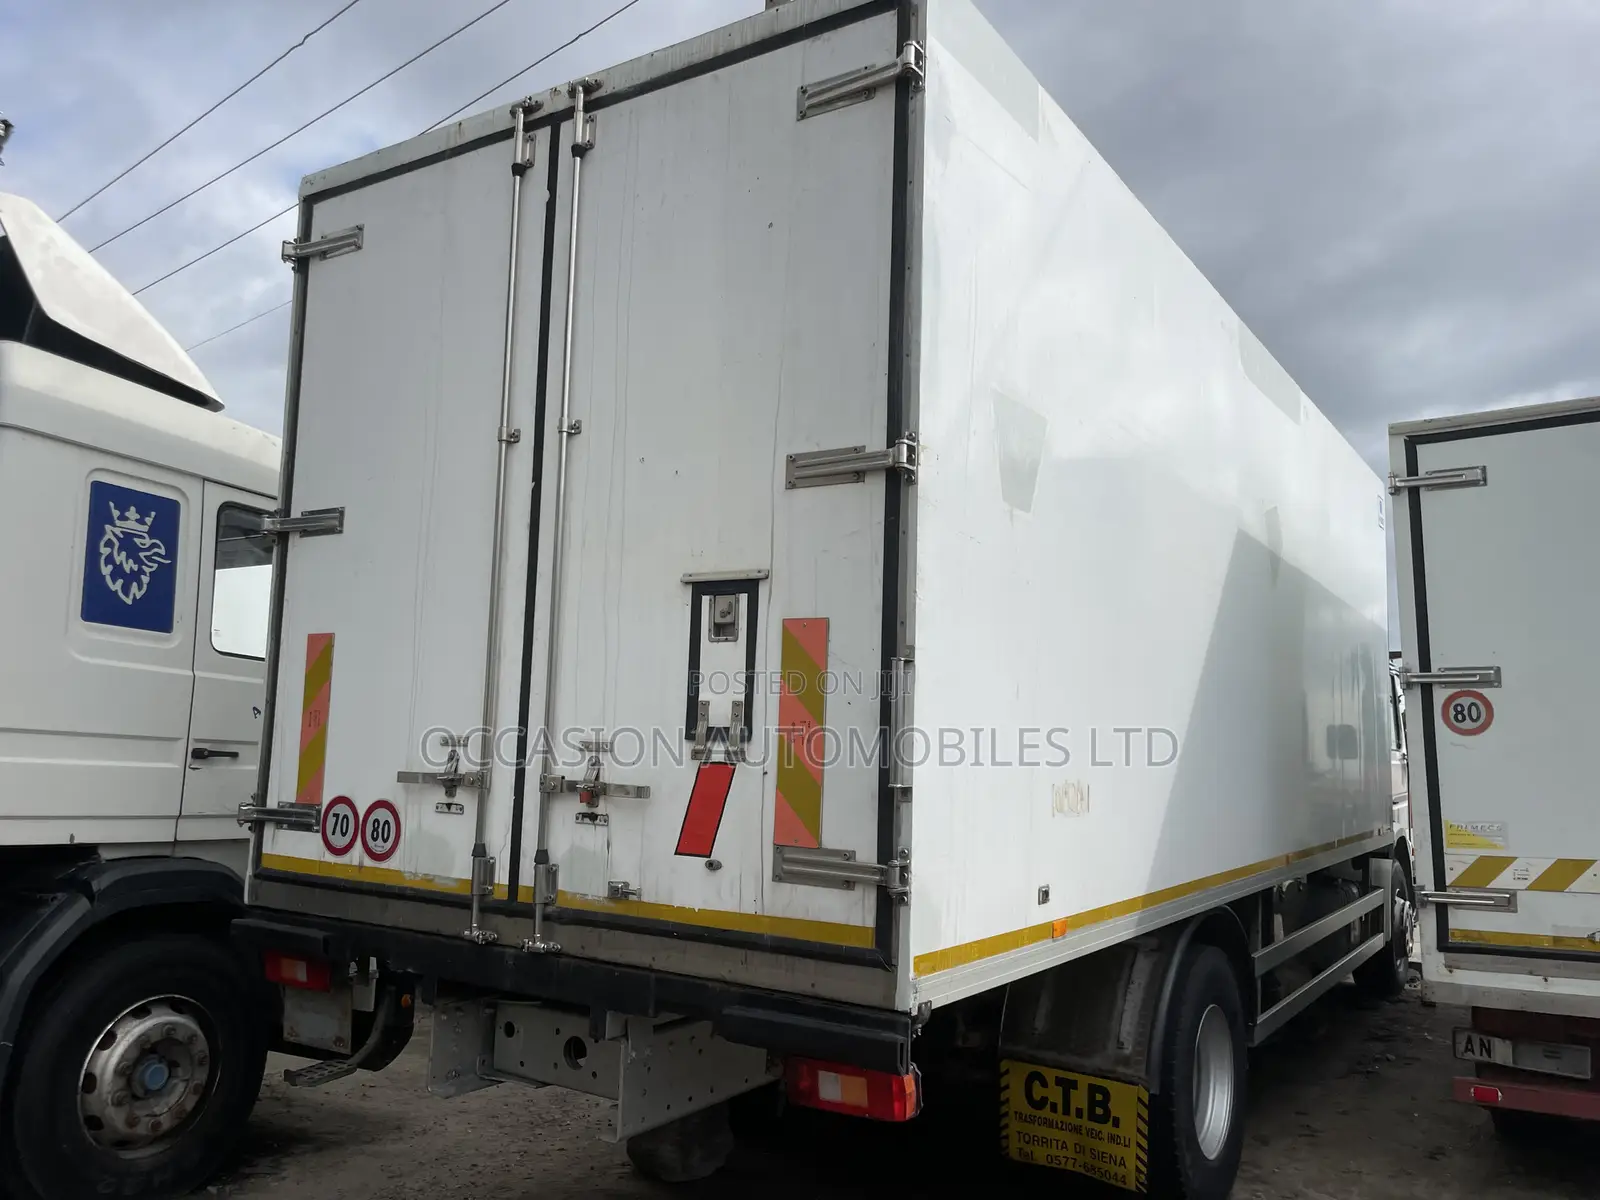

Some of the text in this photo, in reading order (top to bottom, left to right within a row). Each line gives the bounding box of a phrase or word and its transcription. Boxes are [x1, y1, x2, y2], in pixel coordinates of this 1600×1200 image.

[1453, 702, 1482, 723] 80
[331, 812, 350, 838] 70
[370, 817, 391, 843] 80
[1025, 1070, 1120, 1128] C.T.B.
[1014, 1111, 1083, 1135] TRASFORMAZIONE
[1016, 1130, 1127, 1169] TORRITA DI SIENA
